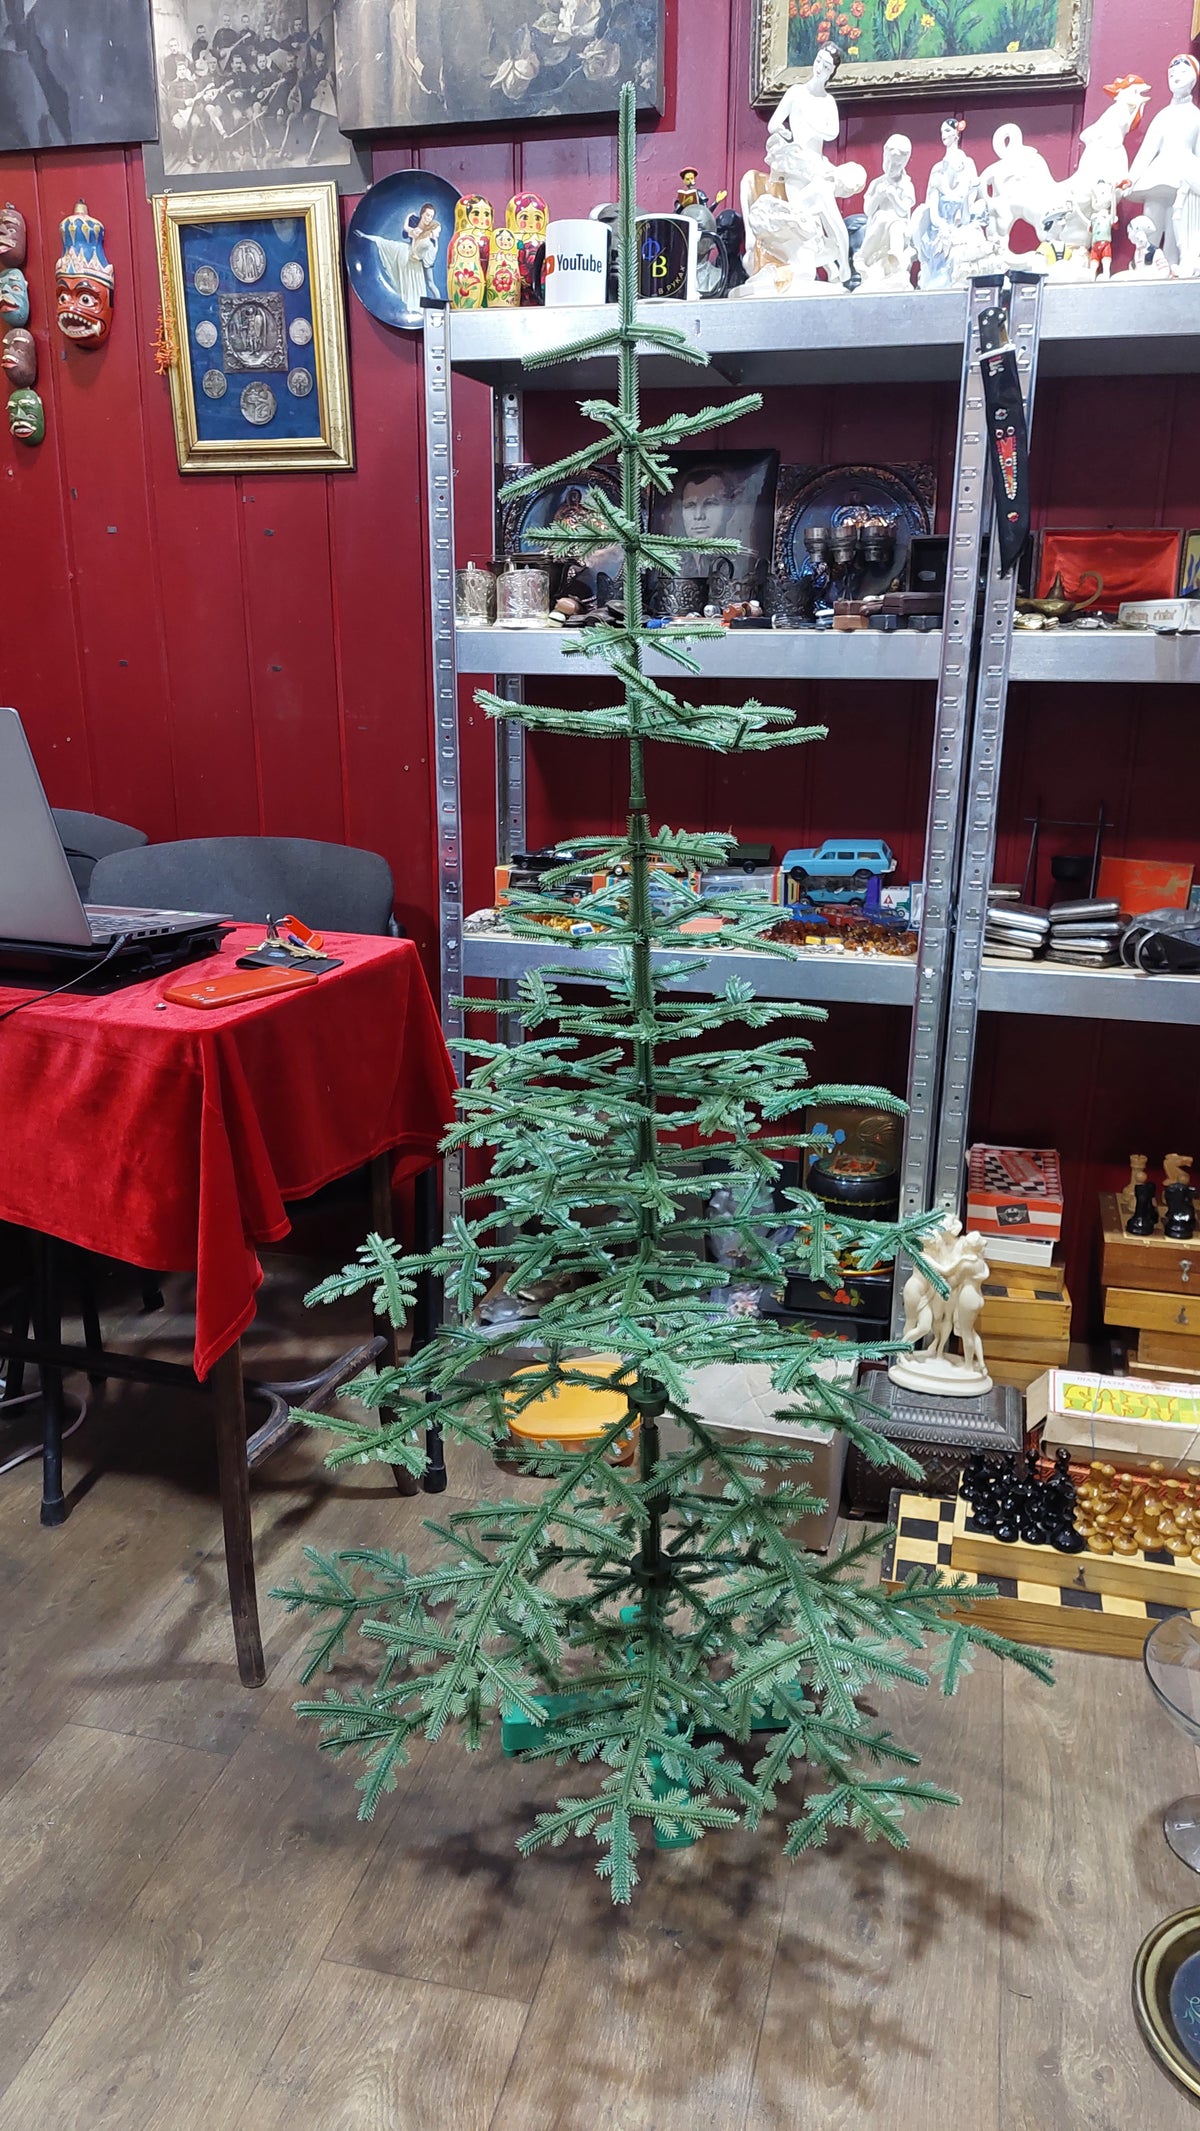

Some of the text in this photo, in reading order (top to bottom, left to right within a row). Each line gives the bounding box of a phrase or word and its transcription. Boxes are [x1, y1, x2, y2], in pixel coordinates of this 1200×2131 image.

[557, 253, 603, 273] YouTube
[658, 265, 686, 295] В РУКАХ
